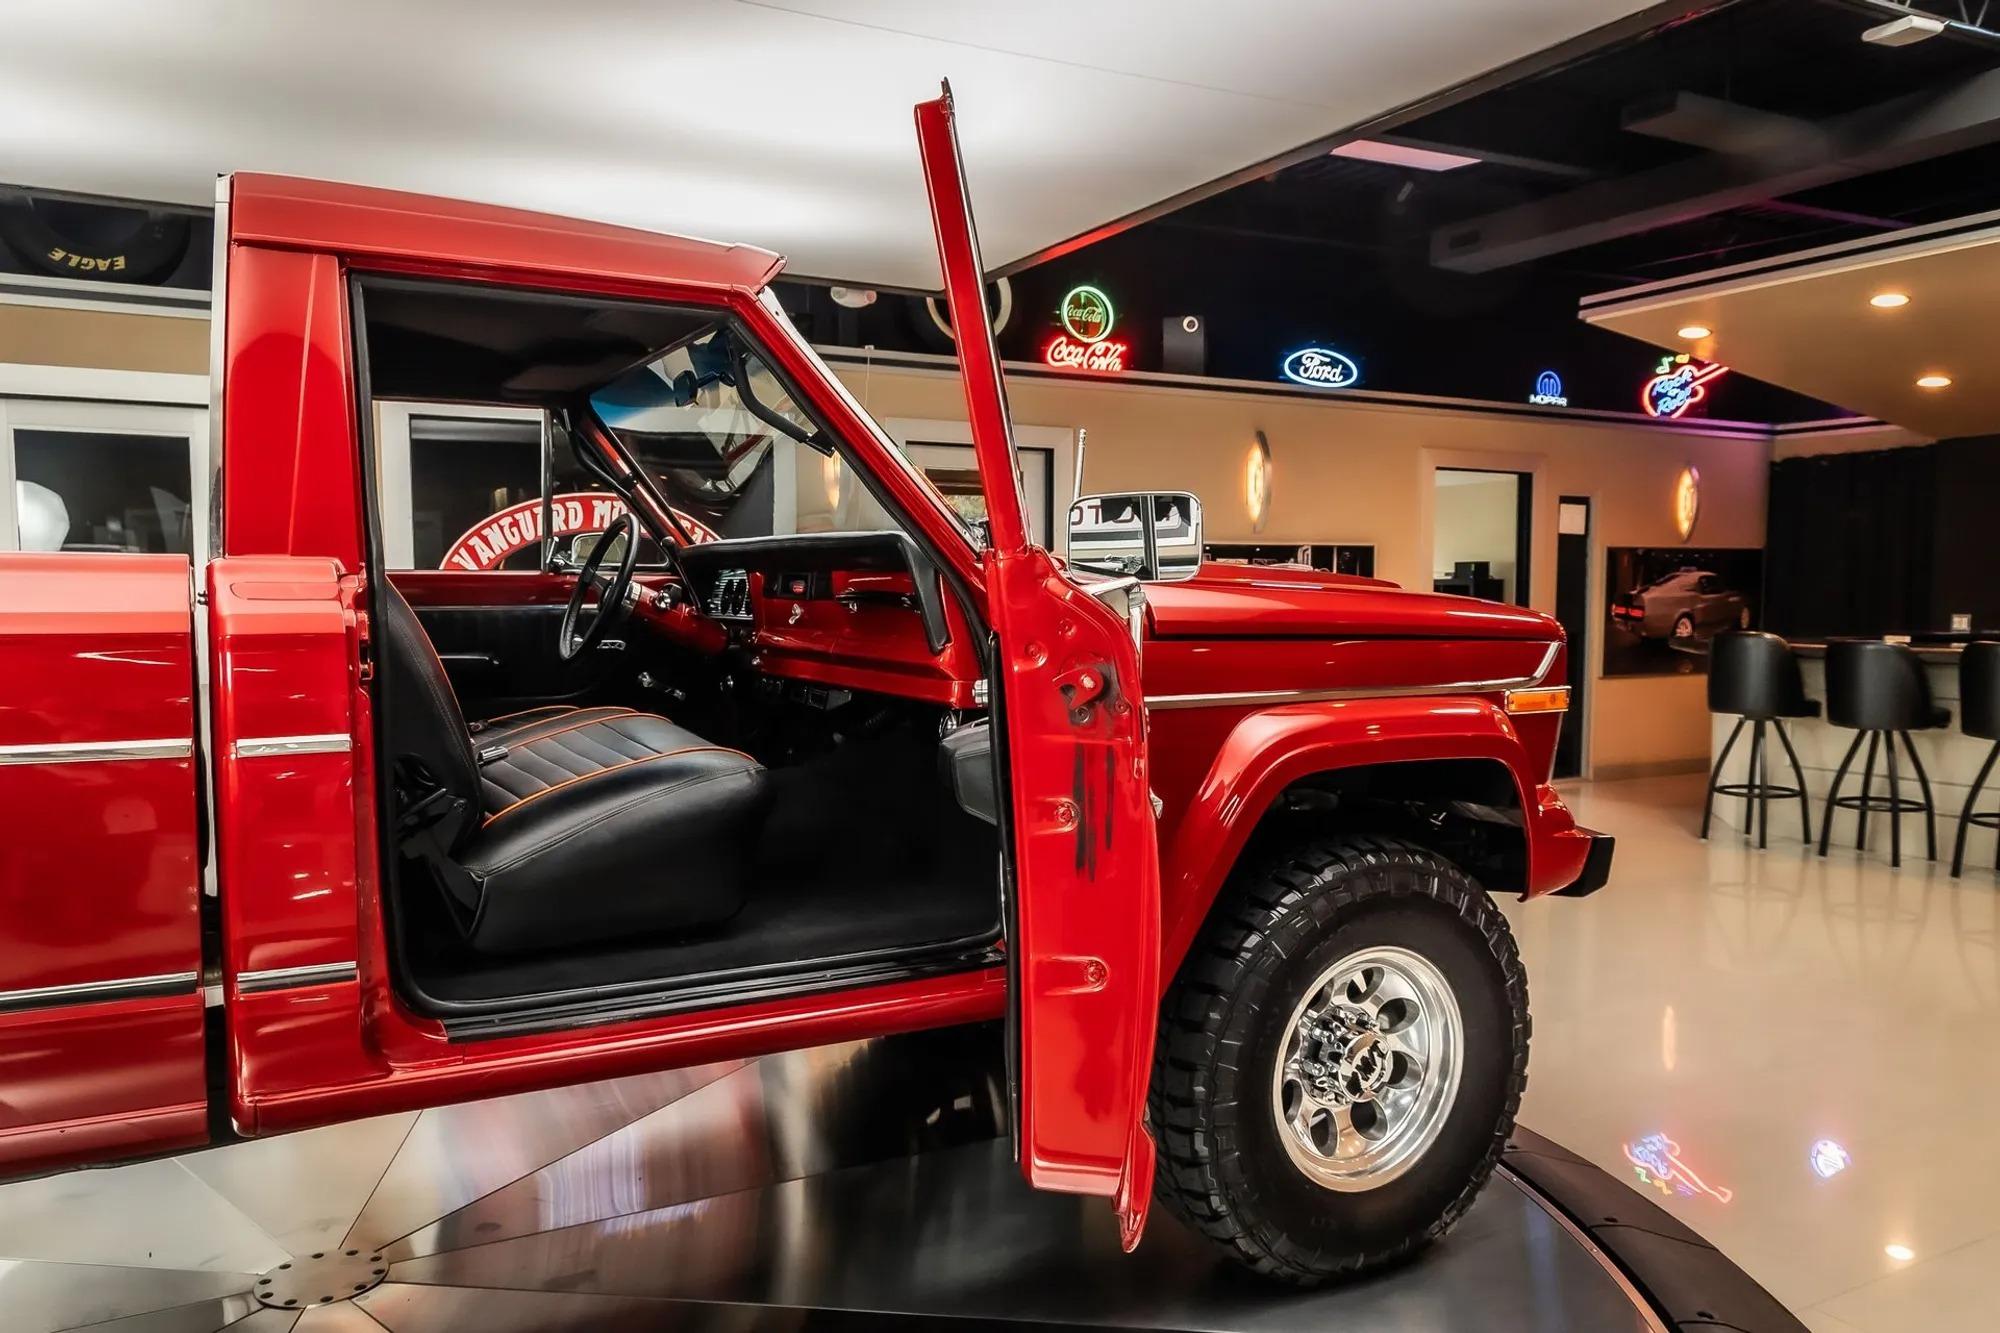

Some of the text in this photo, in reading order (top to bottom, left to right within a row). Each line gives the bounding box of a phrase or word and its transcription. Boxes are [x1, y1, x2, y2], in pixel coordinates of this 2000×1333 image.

[47, 247, 126, 271] EAGLE
[1298, 352, 1344, 382] Ford
[1529, 394, 1568, 407] MOPAR
